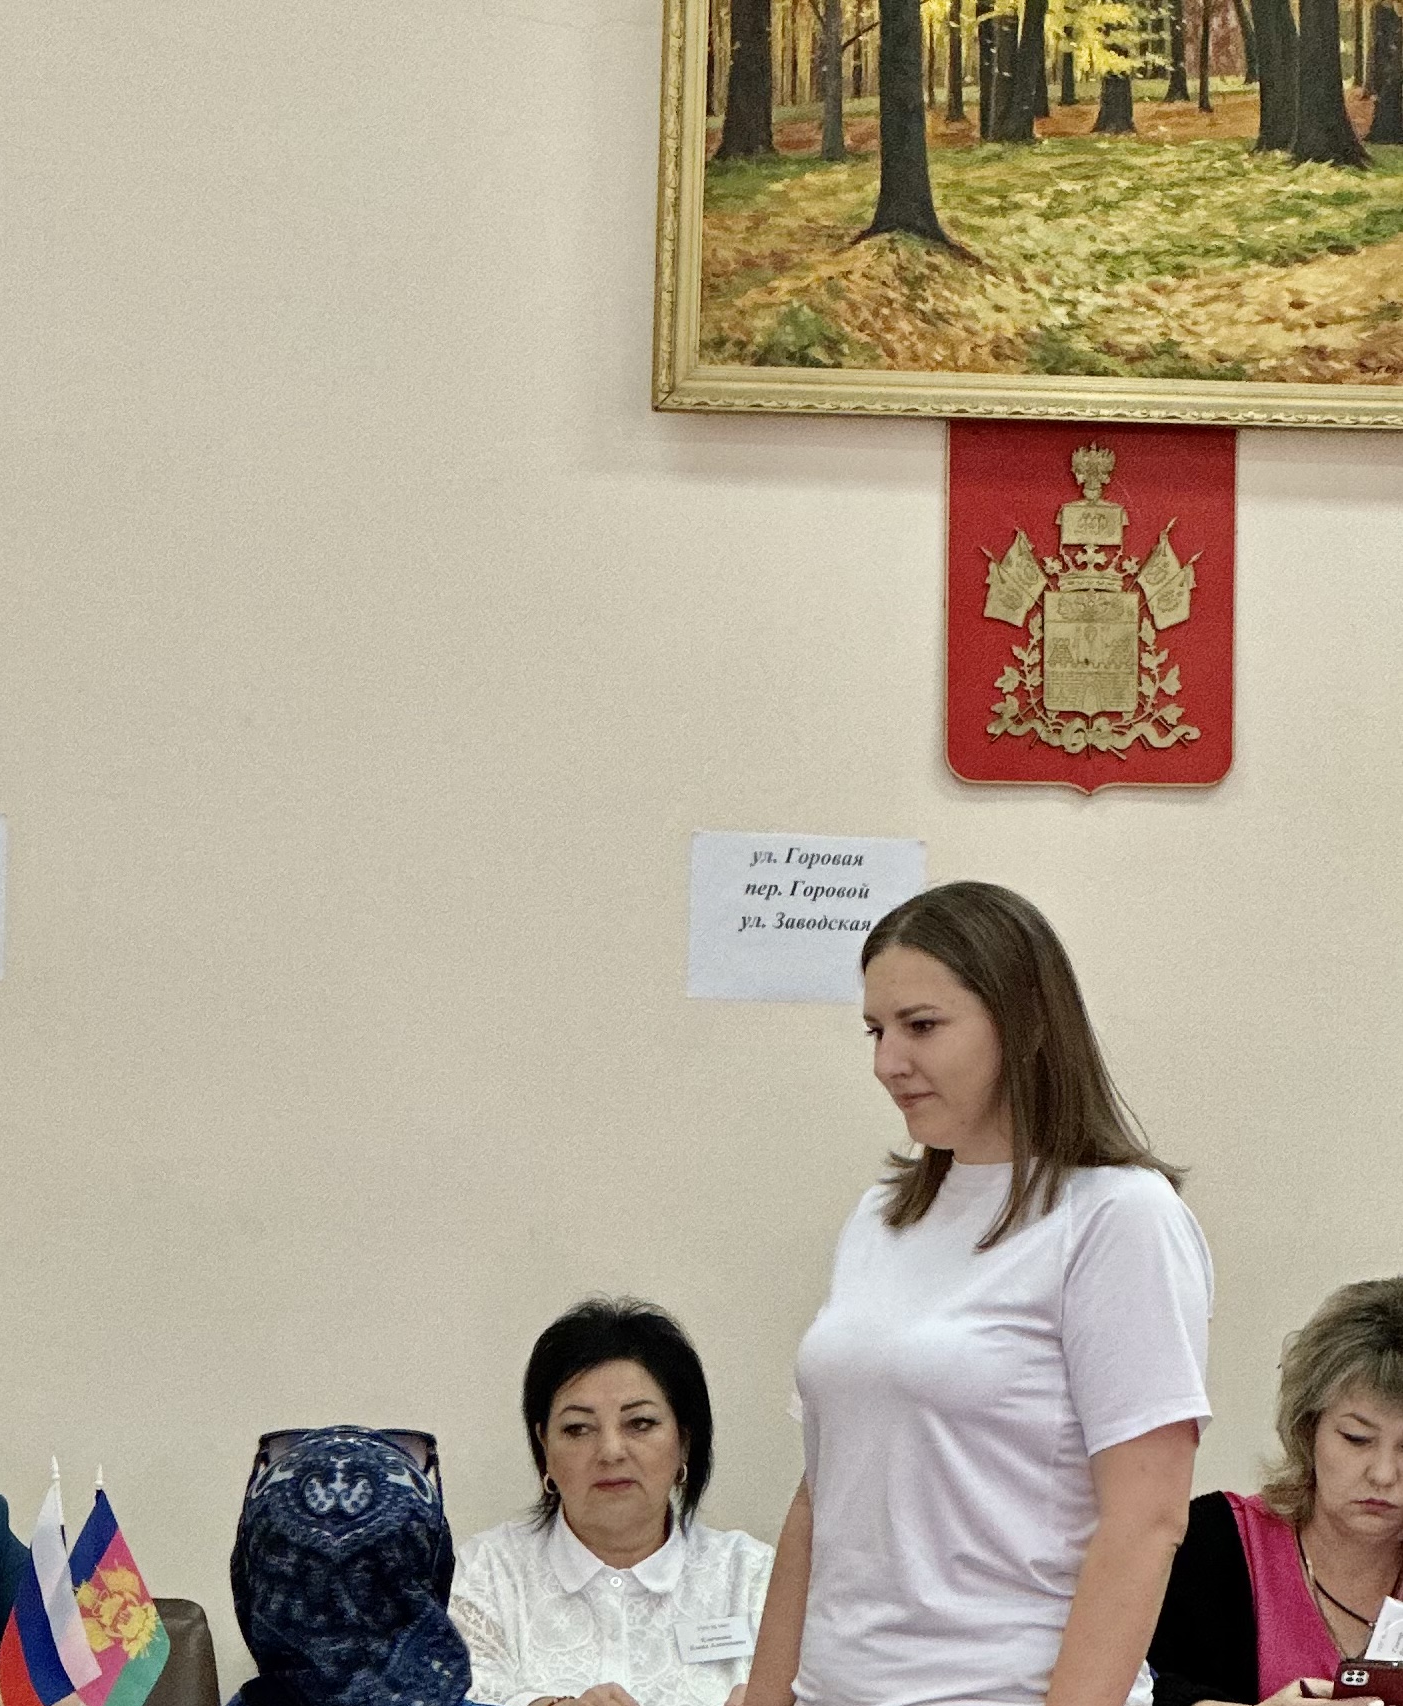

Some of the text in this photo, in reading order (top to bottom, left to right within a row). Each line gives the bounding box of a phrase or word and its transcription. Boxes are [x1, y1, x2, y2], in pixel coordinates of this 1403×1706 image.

[749, 847, 864, 869] ул. Горовая
[745, 881, 870, 901] пер. Горовой
[739, 912, 871, 931] ул. Заводская
